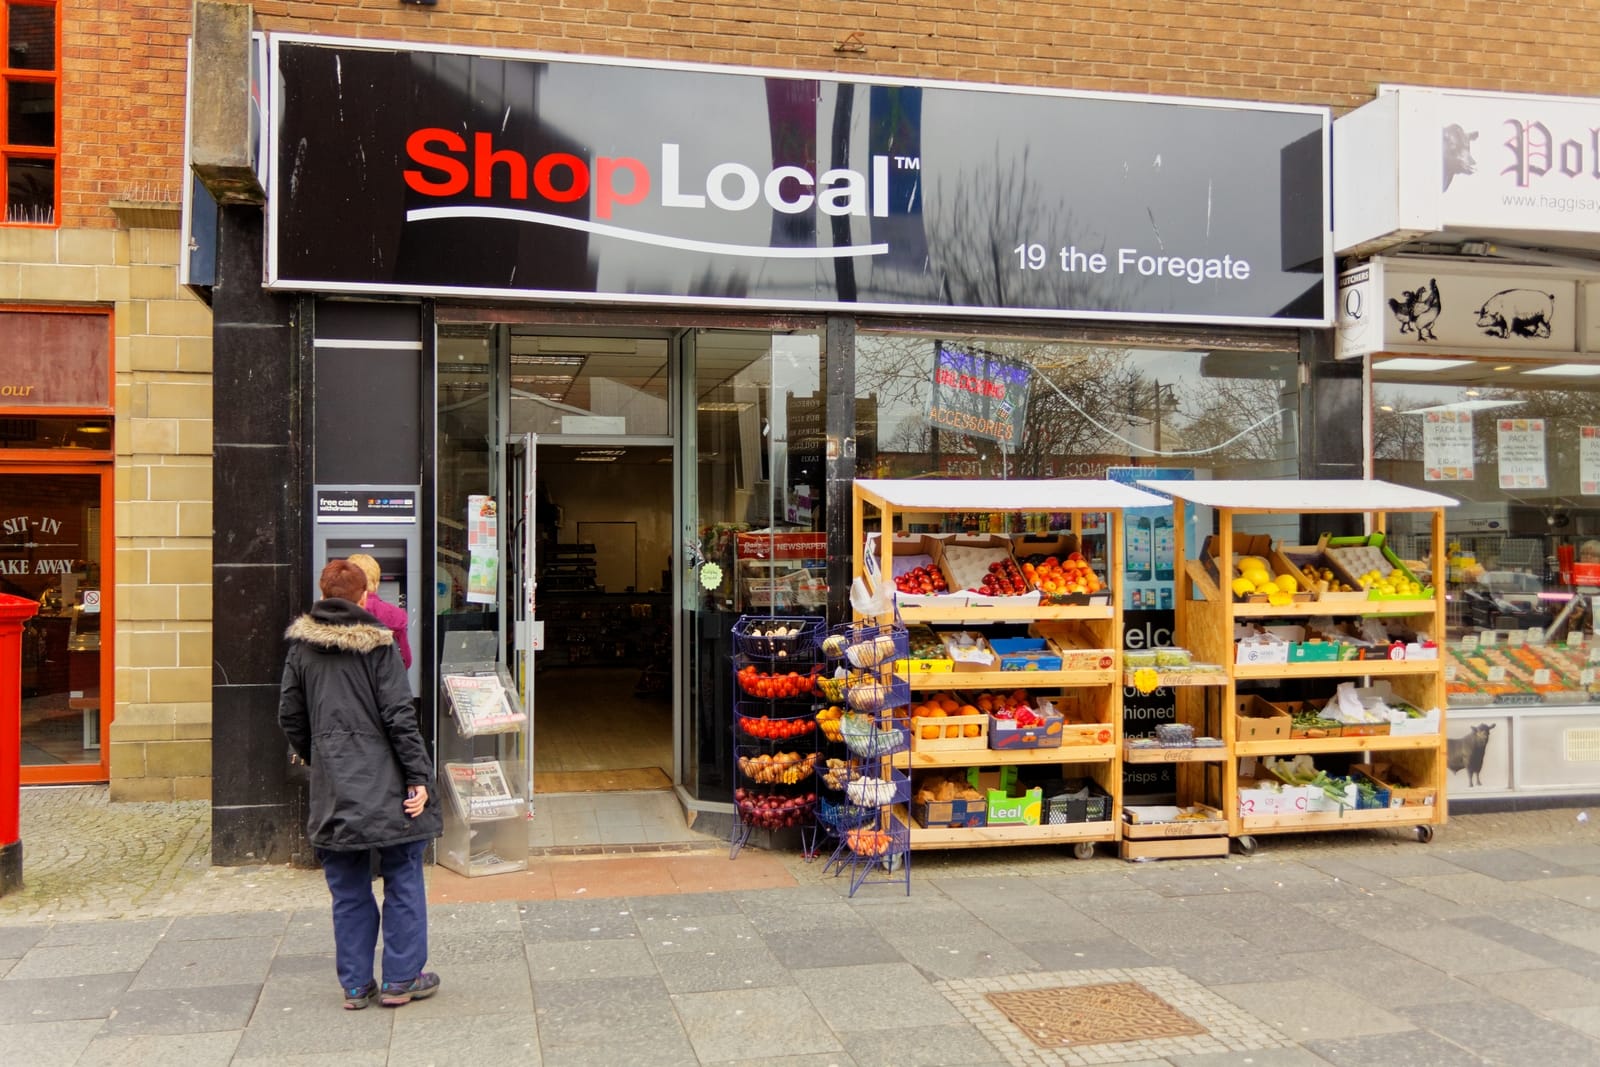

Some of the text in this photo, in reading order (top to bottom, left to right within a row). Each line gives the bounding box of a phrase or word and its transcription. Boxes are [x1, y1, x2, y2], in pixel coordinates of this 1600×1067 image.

[1014, 243, 1250, 284] 19 the Foregate
[929, 405, 1014, 439] ACCESSORIES
[320, 498, 358, 506] free cash
[34, 559, 74, 574] AWAY
[1122, 622, 1176, 649] elc
[991, 805, 1021, 818] Leal
